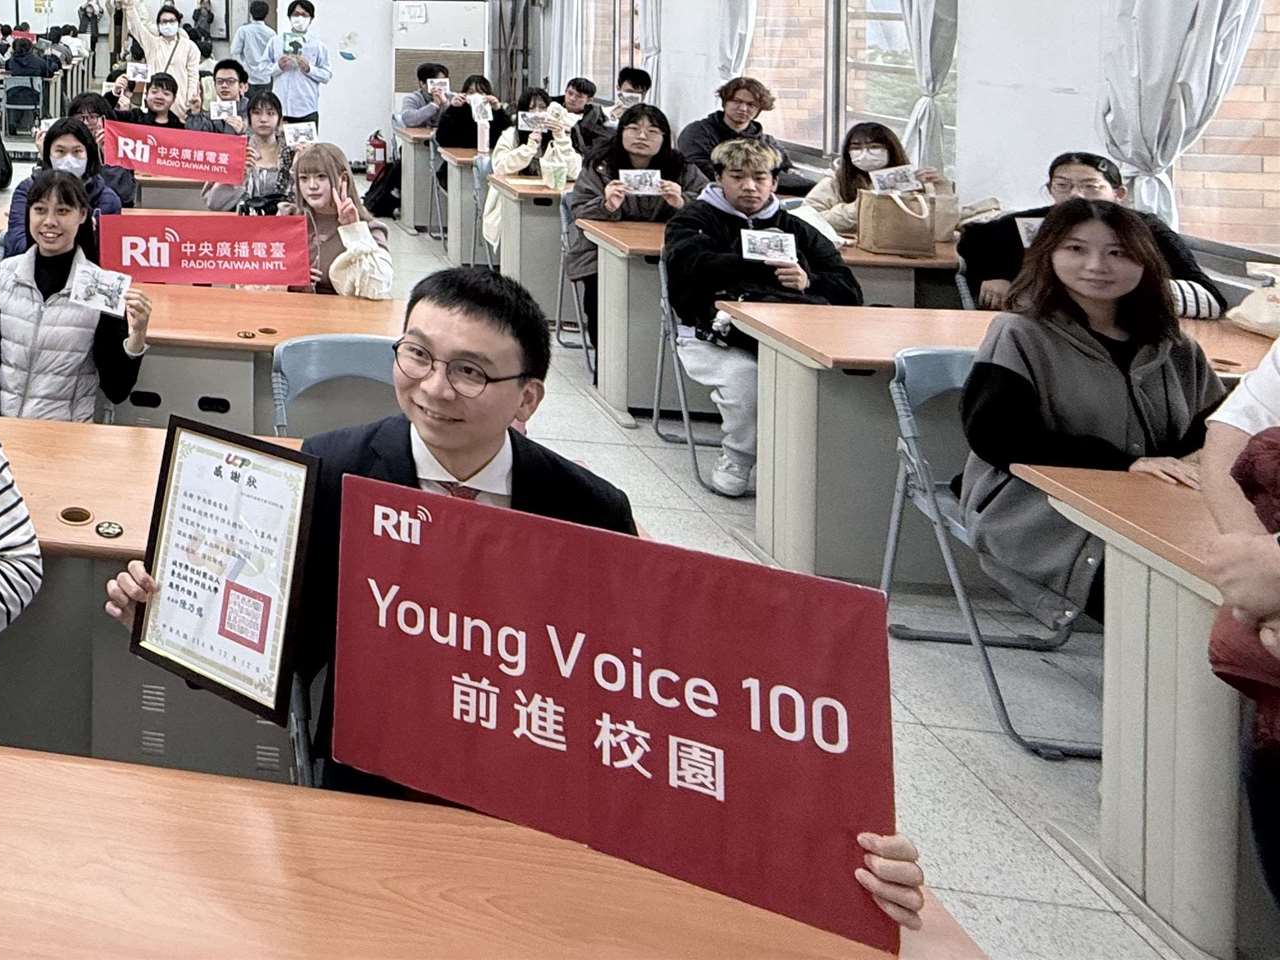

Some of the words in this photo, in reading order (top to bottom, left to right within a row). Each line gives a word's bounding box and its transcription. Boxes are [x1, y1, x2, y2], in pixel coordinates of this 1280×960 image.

[117, 135, 151, 163] Rti
[157, 146, 229, 165] 中央廣播電臺
[156, 159, 180, 168] RADIO
[181, 162, 210, 171] TAIWAN
[121, 235, 169, 268] Rti
[181, 241, 286, 258] 中央廣播電臺
[181, 259, 216, 269] RADIO
[218, 260, 260, 270] TAIWAN
[262, 261, 287, 270] INTL
[373, 504, 421, 545] Rti
[367, 577, 527, 677] Young
[546, 624, 720, 719] Voice
[741, 677, 849, 754] 100
